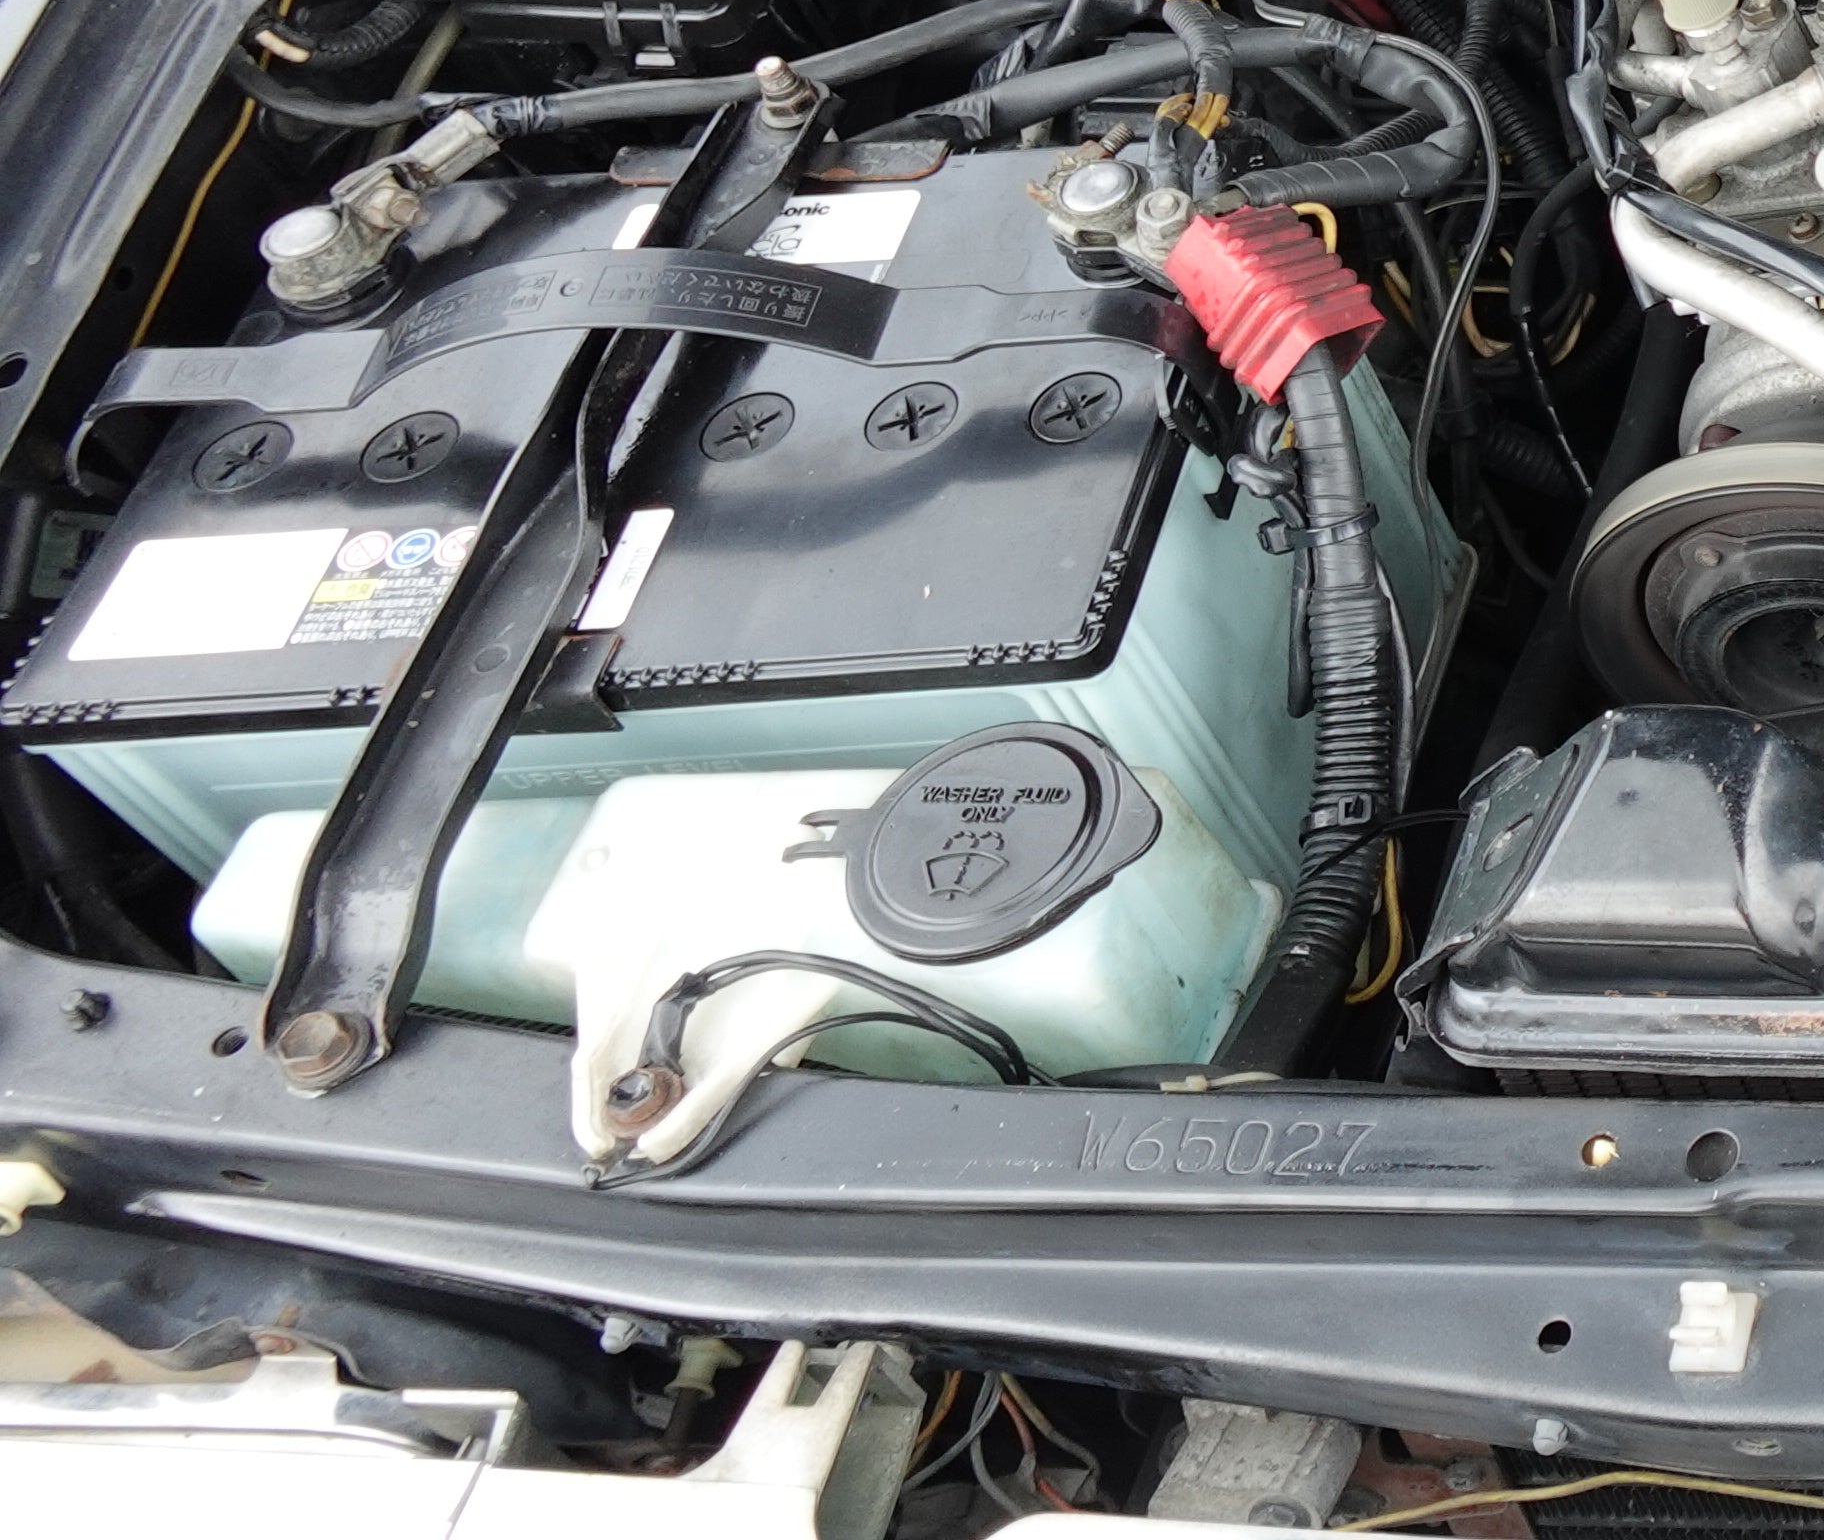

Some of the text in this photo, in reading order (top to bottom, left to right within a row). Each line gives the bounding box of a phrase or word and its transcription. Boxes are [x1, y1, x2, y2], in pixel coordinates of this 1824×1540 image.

[501, 766, 624, 790] UPPER
[919, 784, 1071, 804] WASHER FLUID
[959, 806, 1014, 824] ONLY
[1077, 1114, 1378, 1176] W65027
